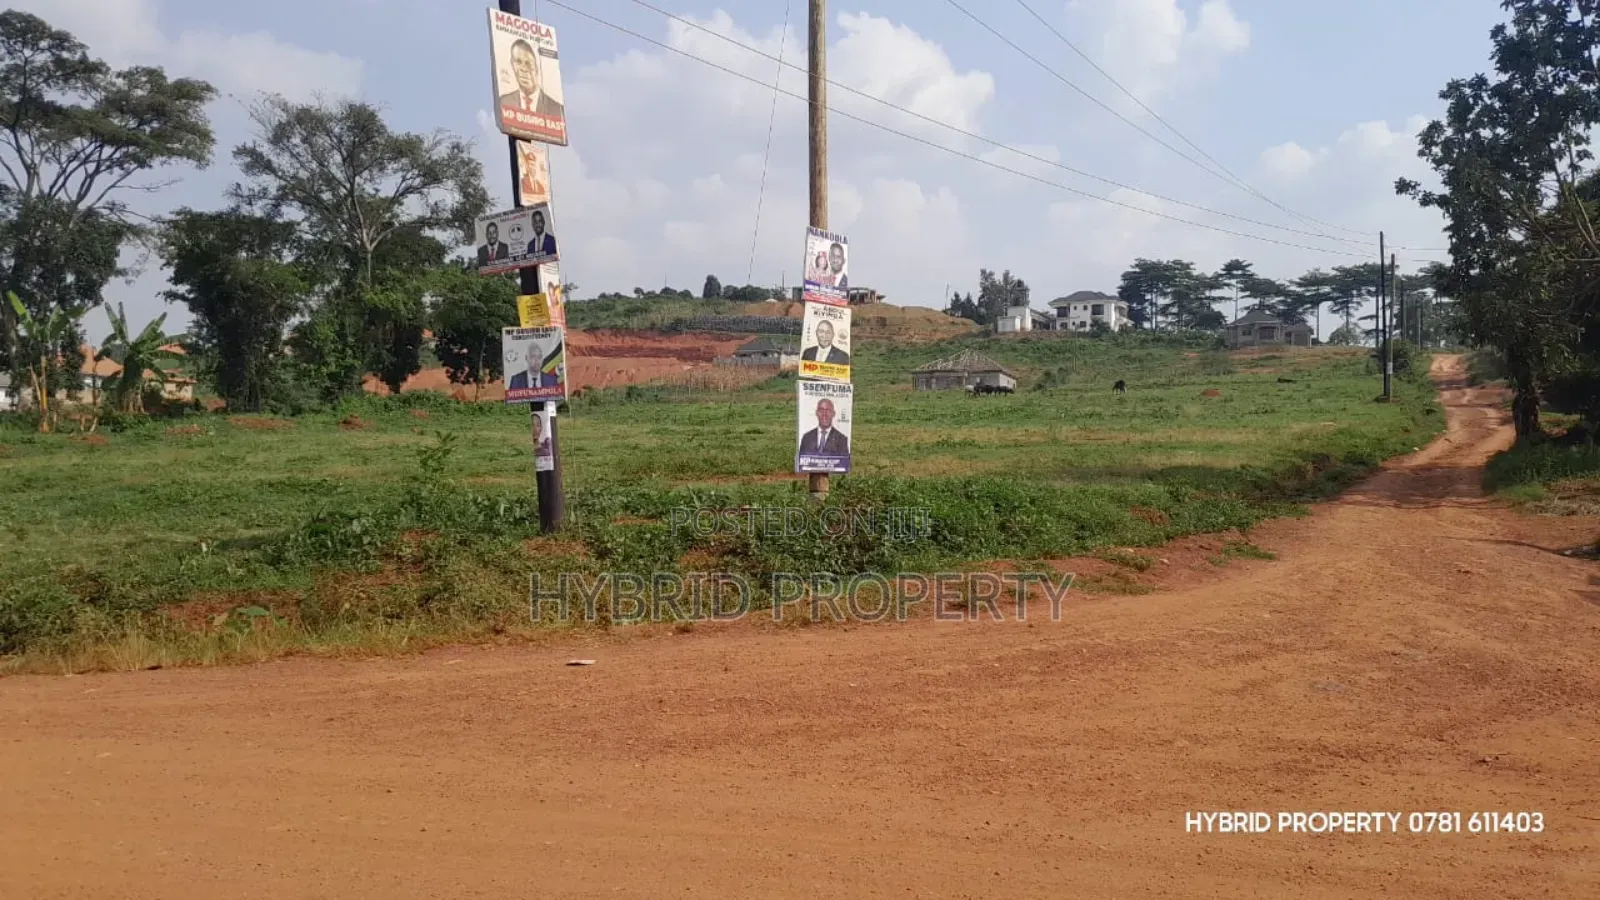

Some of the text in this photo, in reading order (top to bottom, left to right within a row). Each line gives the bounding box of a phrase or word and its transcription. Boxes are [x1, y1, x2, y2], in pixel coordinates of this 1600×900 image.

[502, 107, 515, 119] MP
[545, 119, 565, 131] EAST
[803, 363, 818, 372] MP
